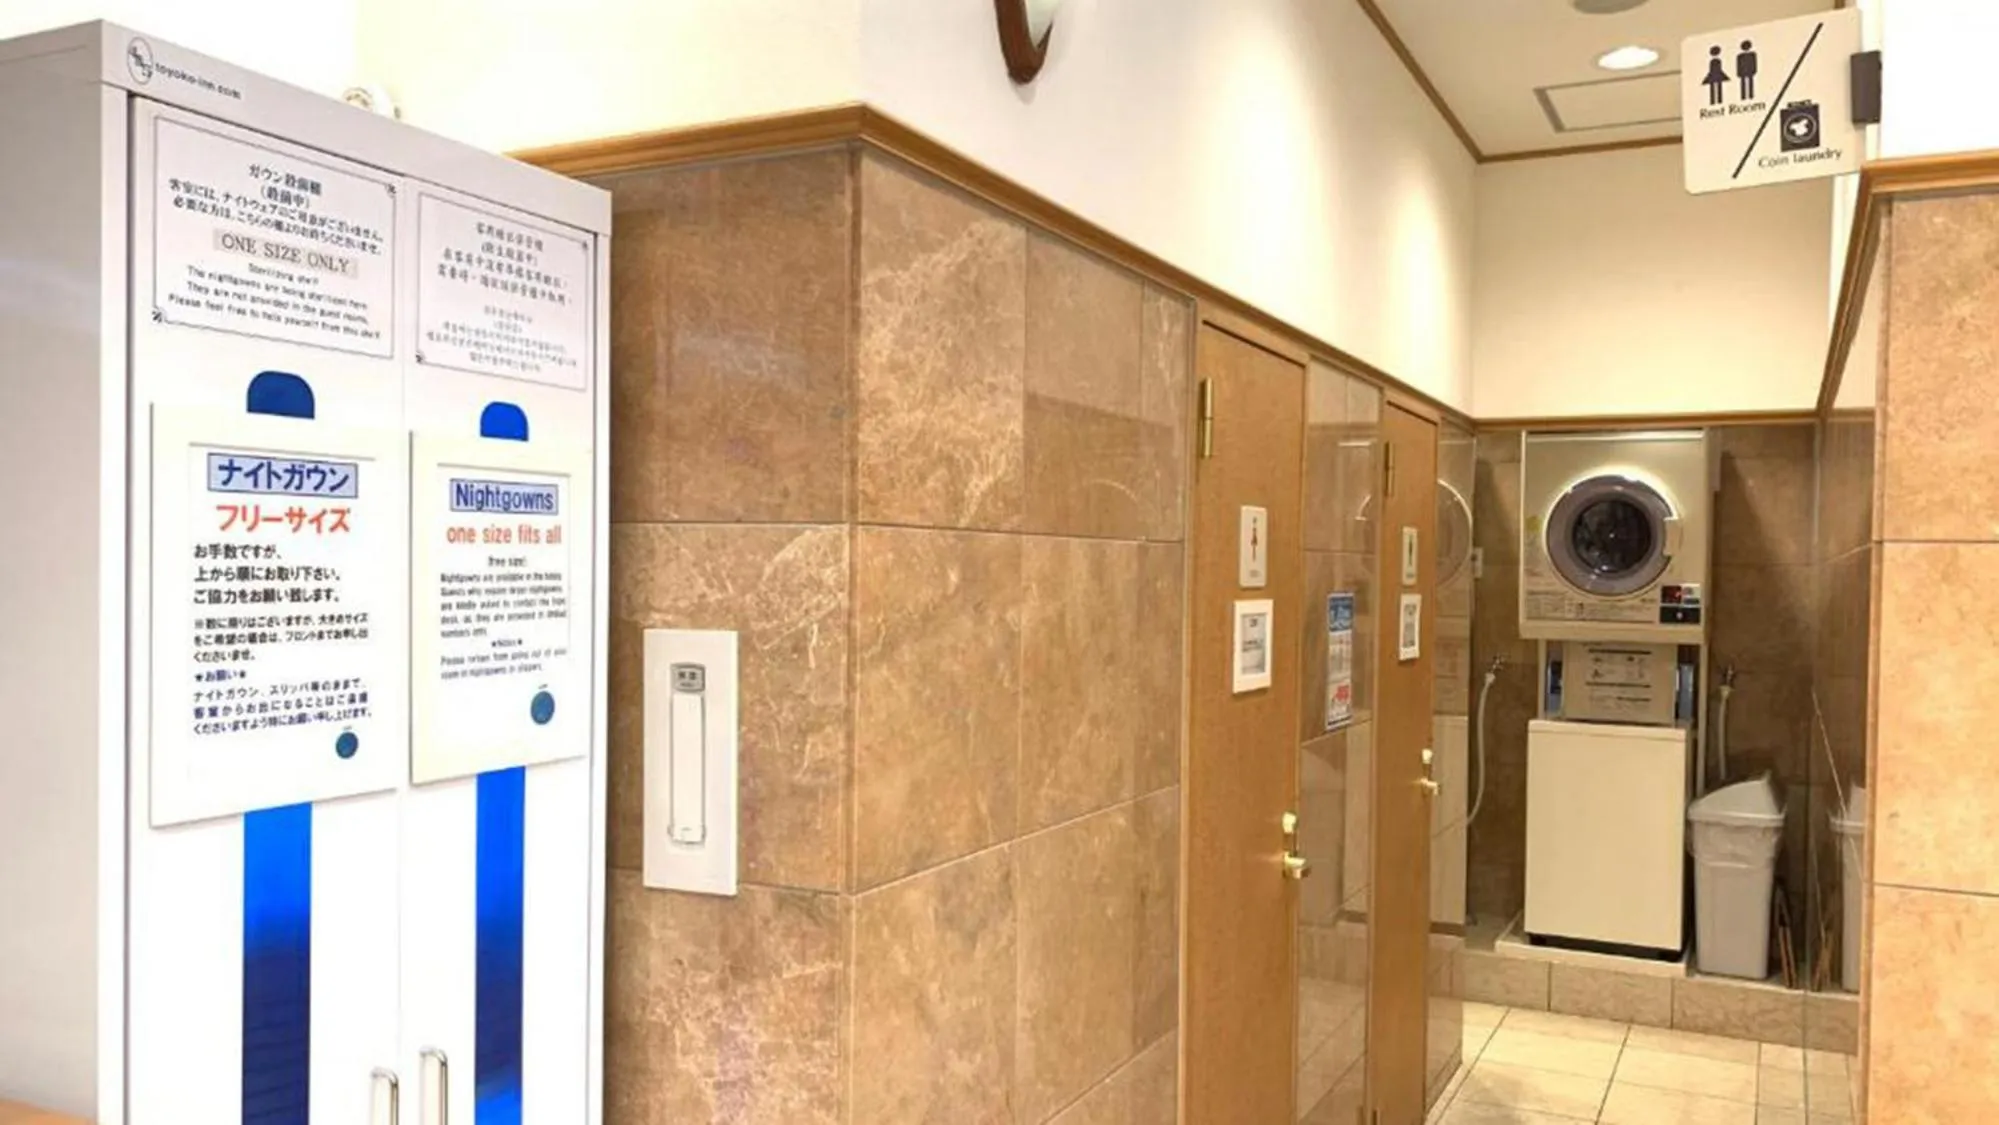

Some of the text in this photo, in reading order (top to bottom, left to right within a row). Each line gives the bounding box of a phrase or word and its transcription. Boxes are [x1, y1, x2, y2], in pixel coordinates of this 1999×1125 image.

[1699, 101, 1766, 119] Rest Room
[1758, 148, 1842, 168] Coin laundry
[222, 233, 349, 273] ONE SIZE ONLY
[168, 293, 200, 308] Please
[218, 458, 350, 492] ナイトガウン
[456, 483, 554, 511] Nightgowns
[216, 504, 352, 534] フリーサイズ
[446, 524, 562, 544] one size fits all
[194, 543, 282, 560] お手数ですが、
[194, 565, 340, 582] 上から順にお取り下さい。
[194, 587, 339, 604] ご協力をお願い致します。
[193, 649, 256, 663] くださいませ。
